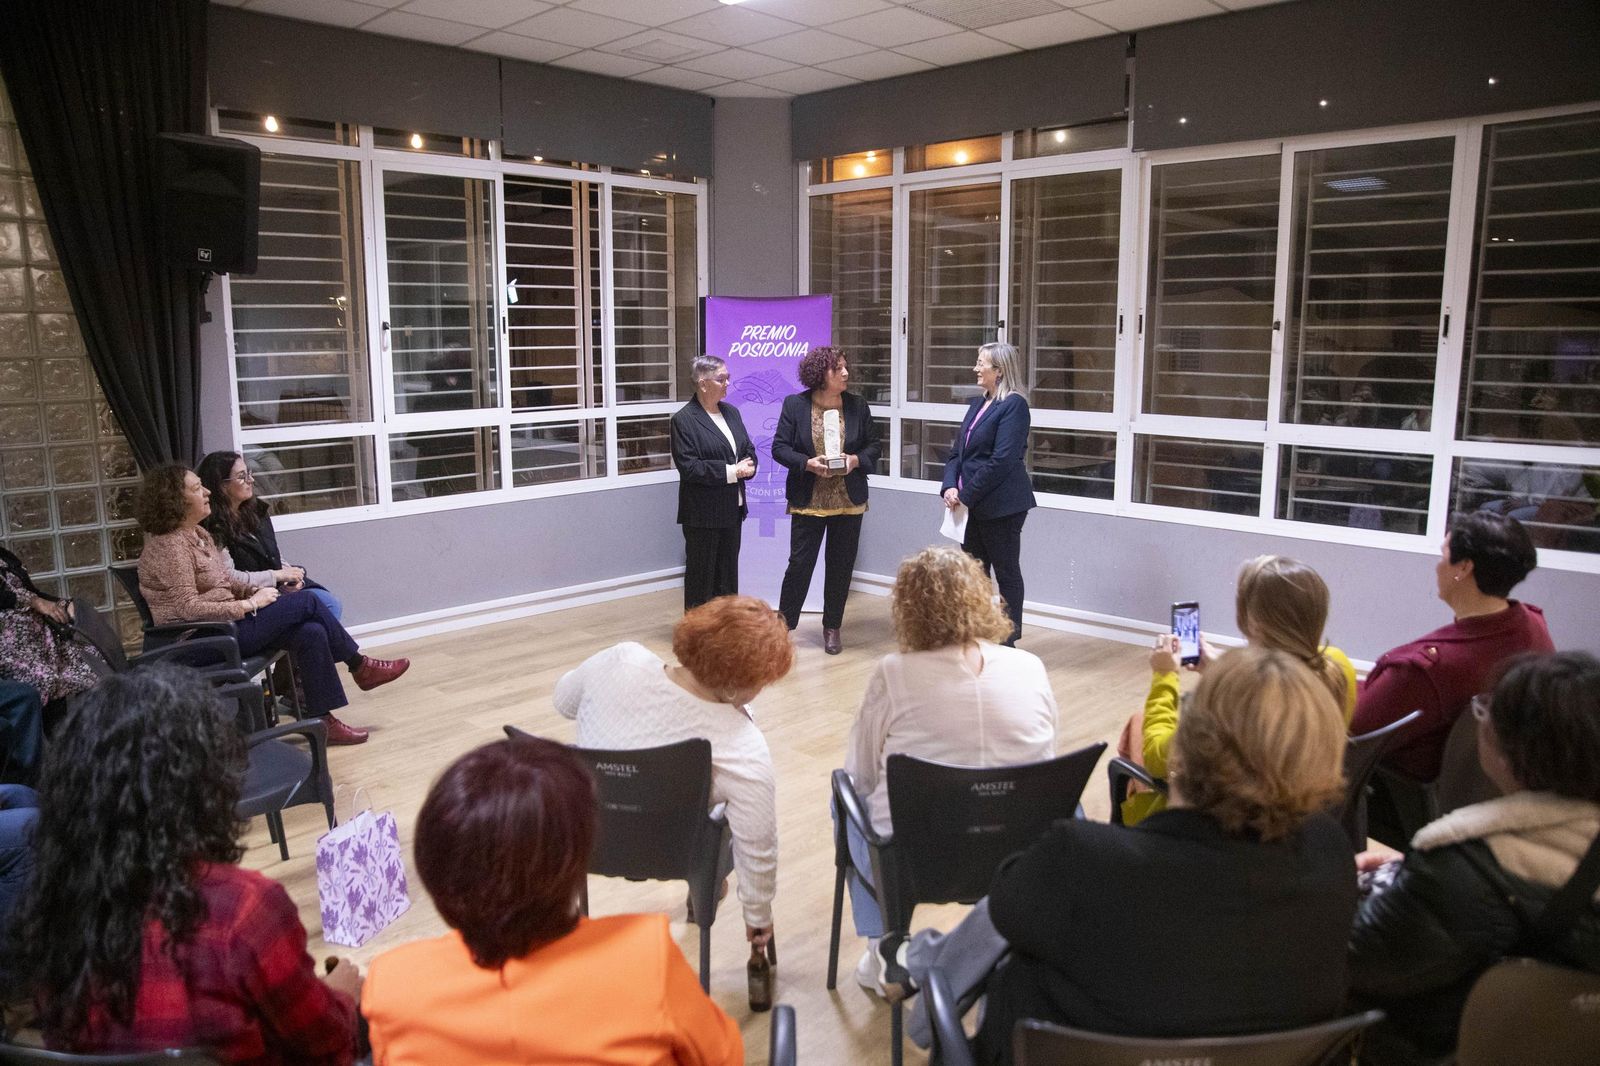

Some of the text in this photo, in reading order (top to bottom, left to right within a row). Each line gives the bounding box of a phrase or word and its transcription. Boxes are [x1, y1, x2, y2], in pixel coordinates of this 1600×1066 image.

[740, 324, 797, 340] PREMIO
[728, 341, 809, 357] POSIDONIA
[595, 761, 640, 773] AMSTEL
[970, 781, 1016, 792] AMSTEL
